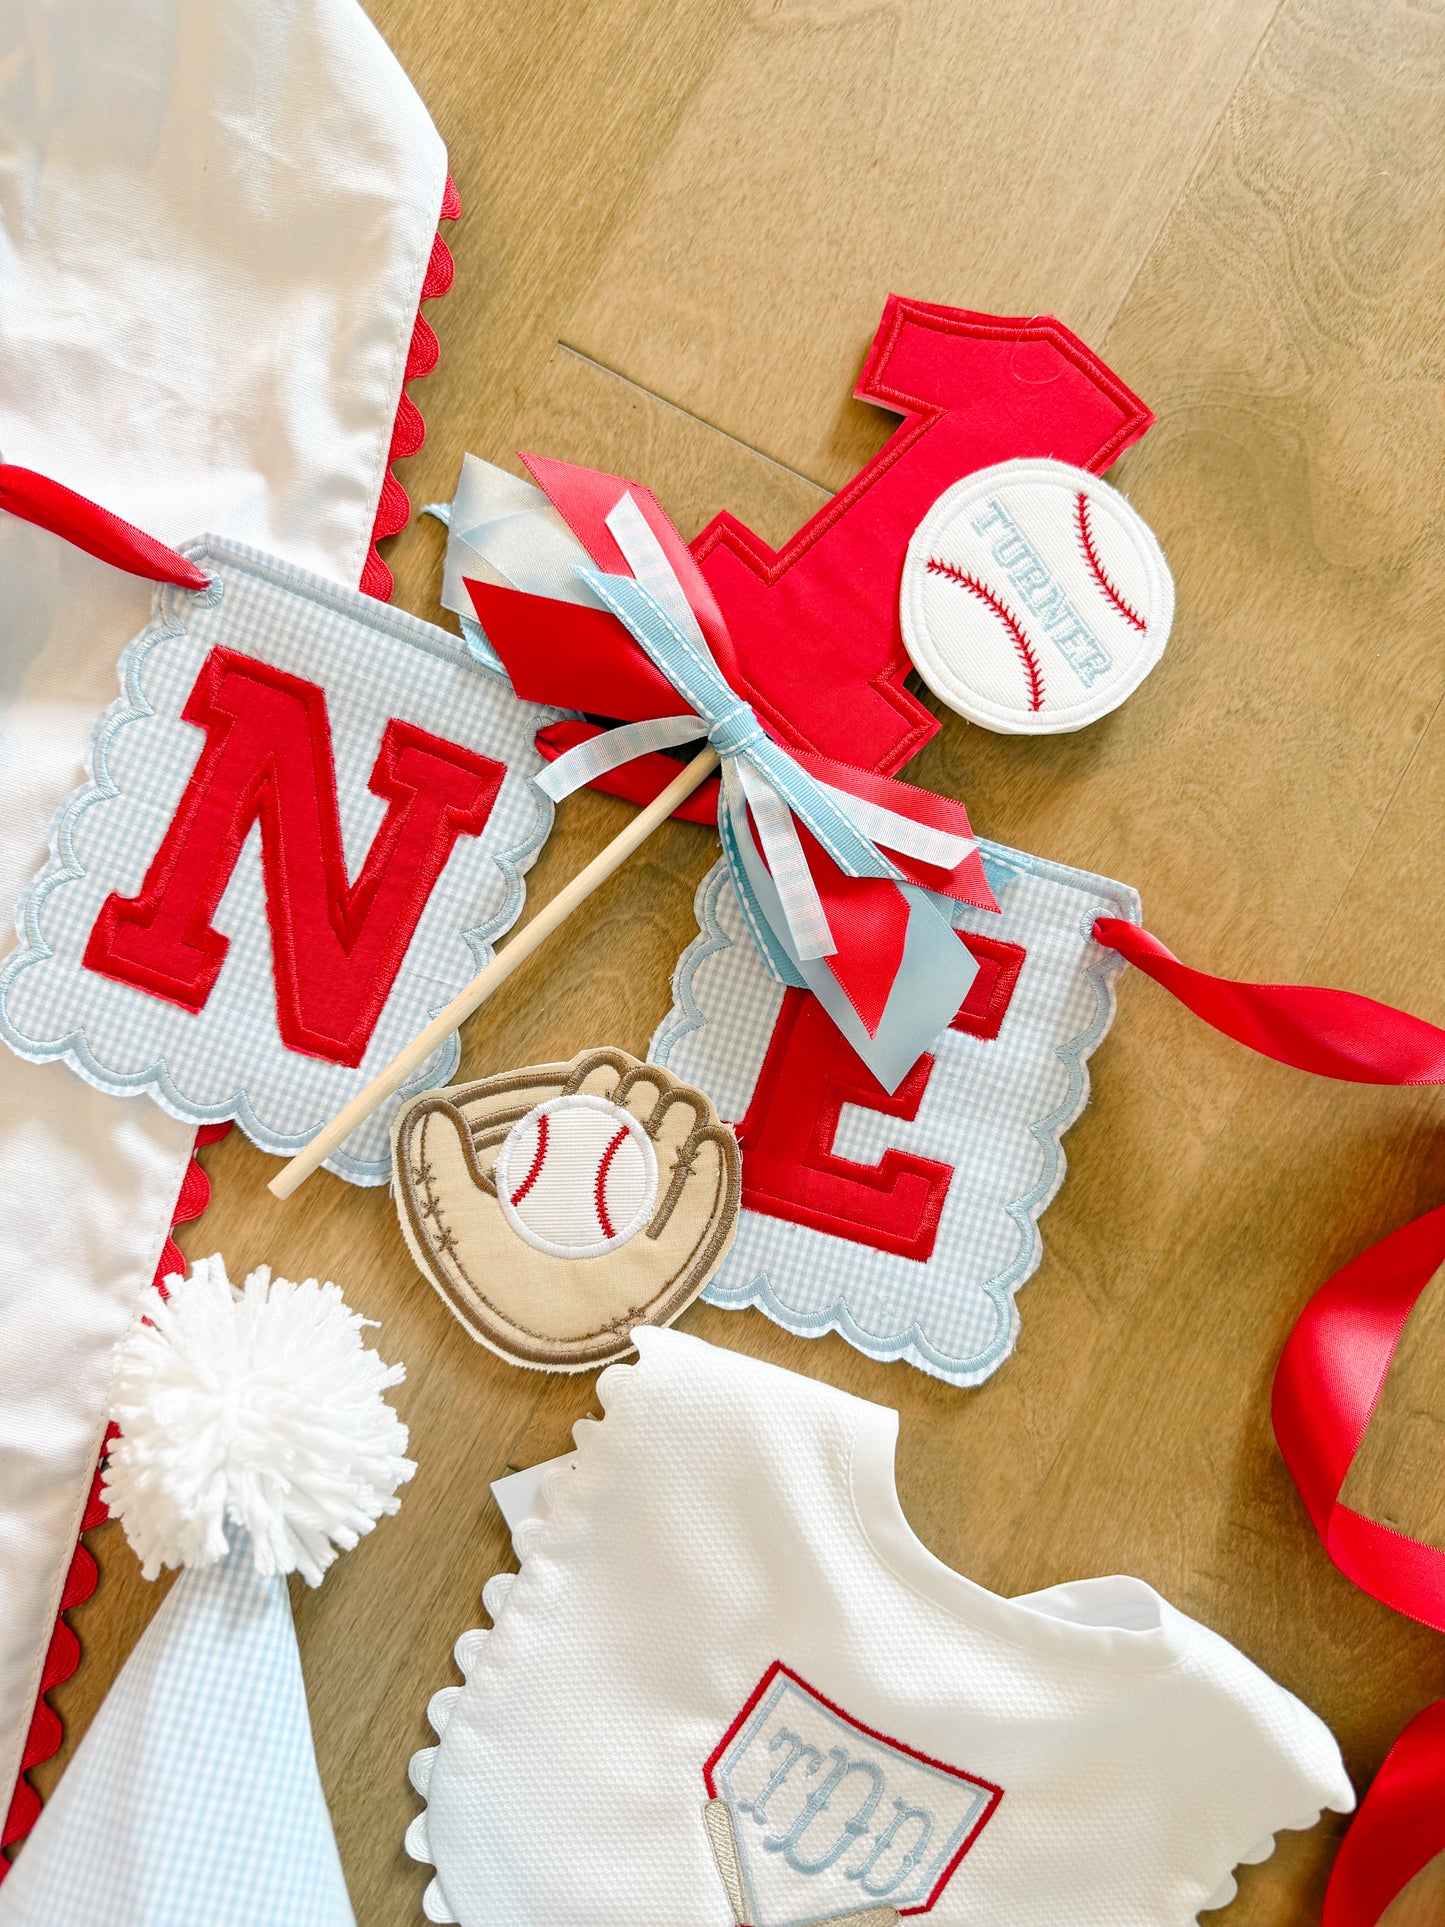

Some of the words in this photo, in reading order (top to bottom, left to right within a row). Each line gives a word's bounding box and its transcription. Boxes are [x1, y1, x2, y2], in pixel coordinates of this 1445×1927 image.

[688, 293, 1156, 777] 1
[970, 493, 1113, 689] TURNER
[82, 645, 507, 1069] N
[721, 930, 1026, 1264] E
